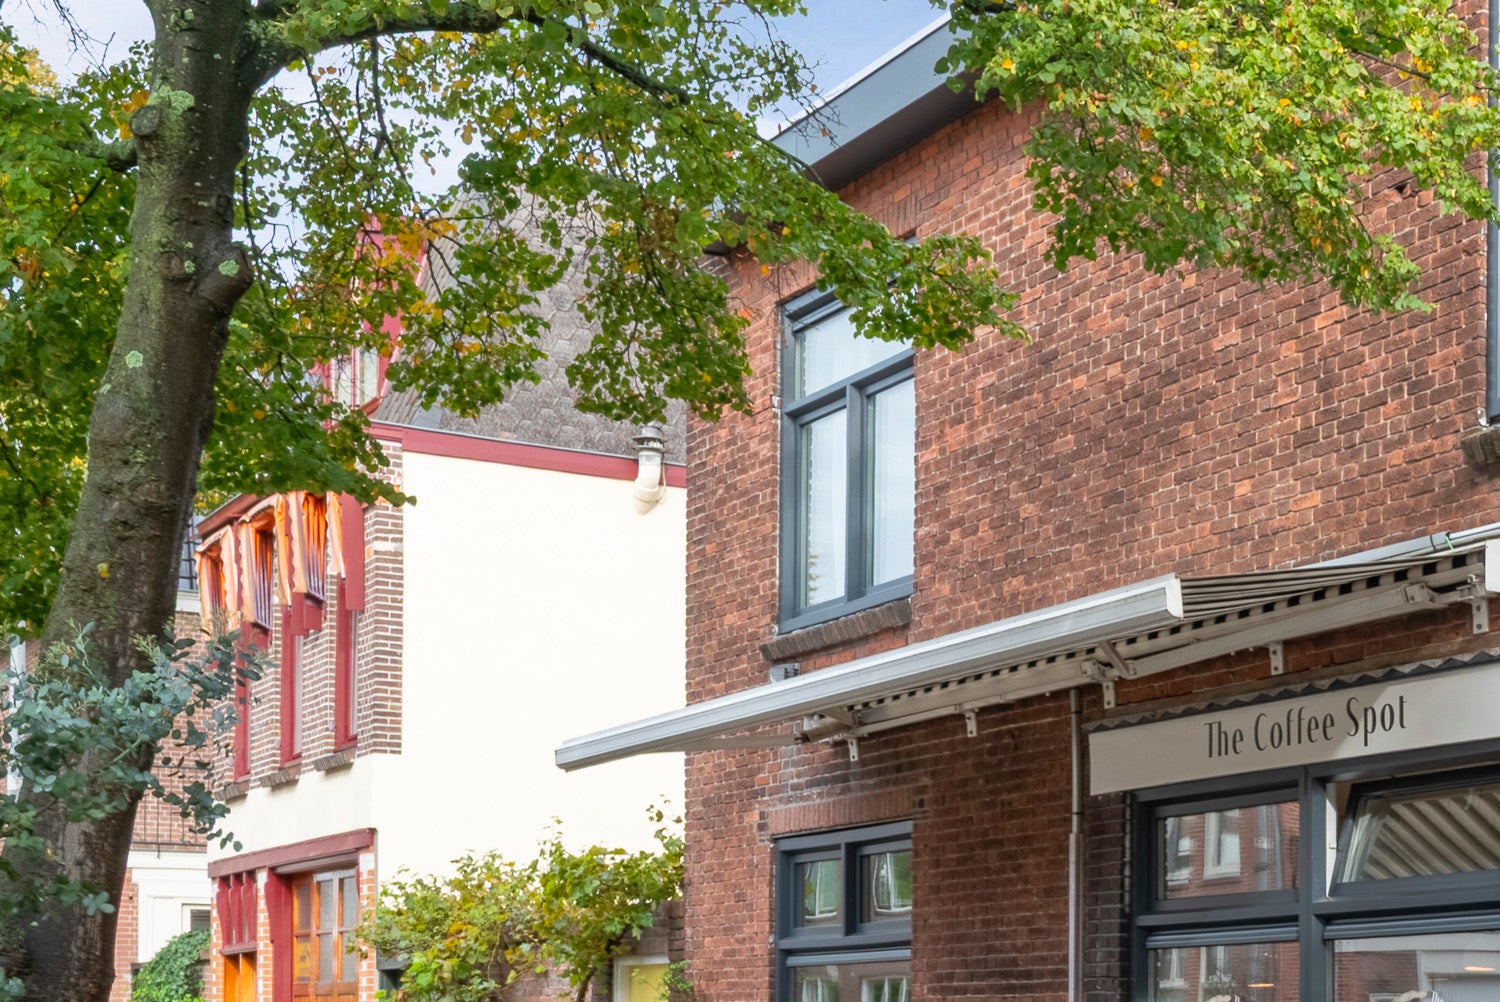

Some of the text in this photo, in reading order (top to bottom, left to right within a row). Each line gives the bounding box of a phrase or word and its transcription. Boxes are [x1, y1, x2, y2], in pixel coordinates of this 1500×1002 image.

[1204, 695, 1408, 758] The Coffee Spot
